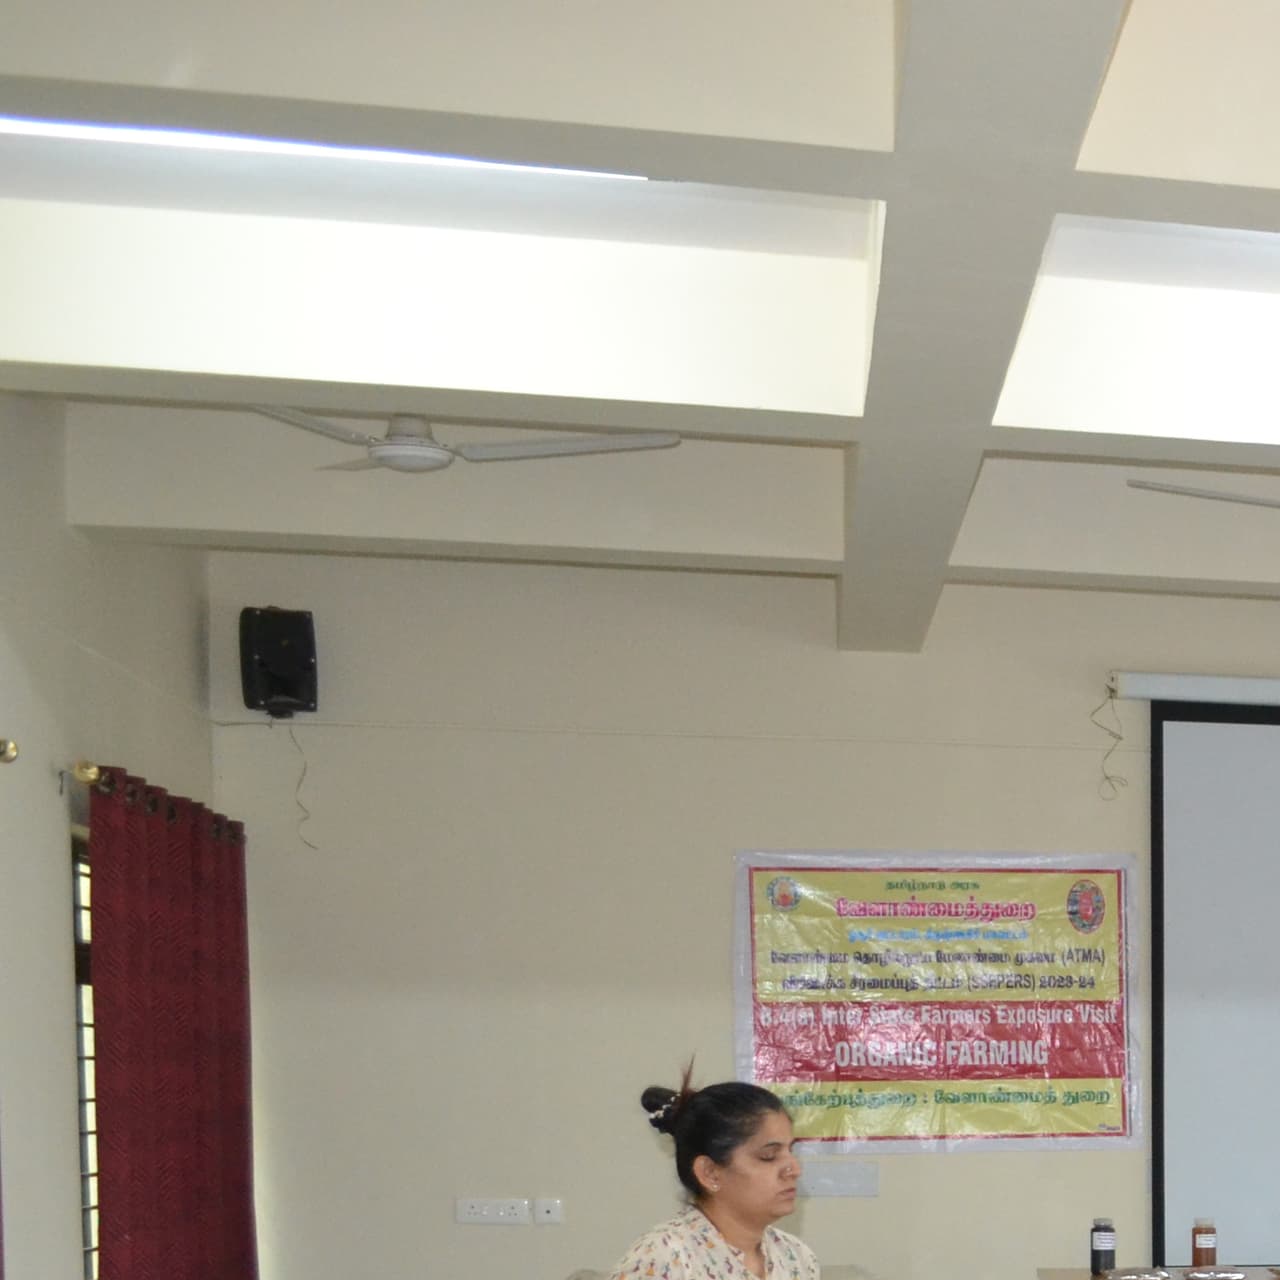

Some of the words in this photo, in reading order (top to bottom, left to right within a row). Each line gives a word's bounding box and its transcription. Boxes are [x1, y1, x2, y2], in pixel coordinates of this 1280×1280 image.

[836, 895, 1038, 922] வேளாண்மைத்துறை
[1061, 948, 1105, 966] (ATMA)
[869, 1004, 916, 1025] State
[921, 1004, 992, 1024] Farmers
[997, 1003, 1074, 1028] Exposure
[1079, 1002, 1118, 1024] Visit
[835, 1039, 938, 1068] ORGANIC
[946, 1039, 1049, 1066] FARMING
[1063, 1090, 1111, 1107] துறை
